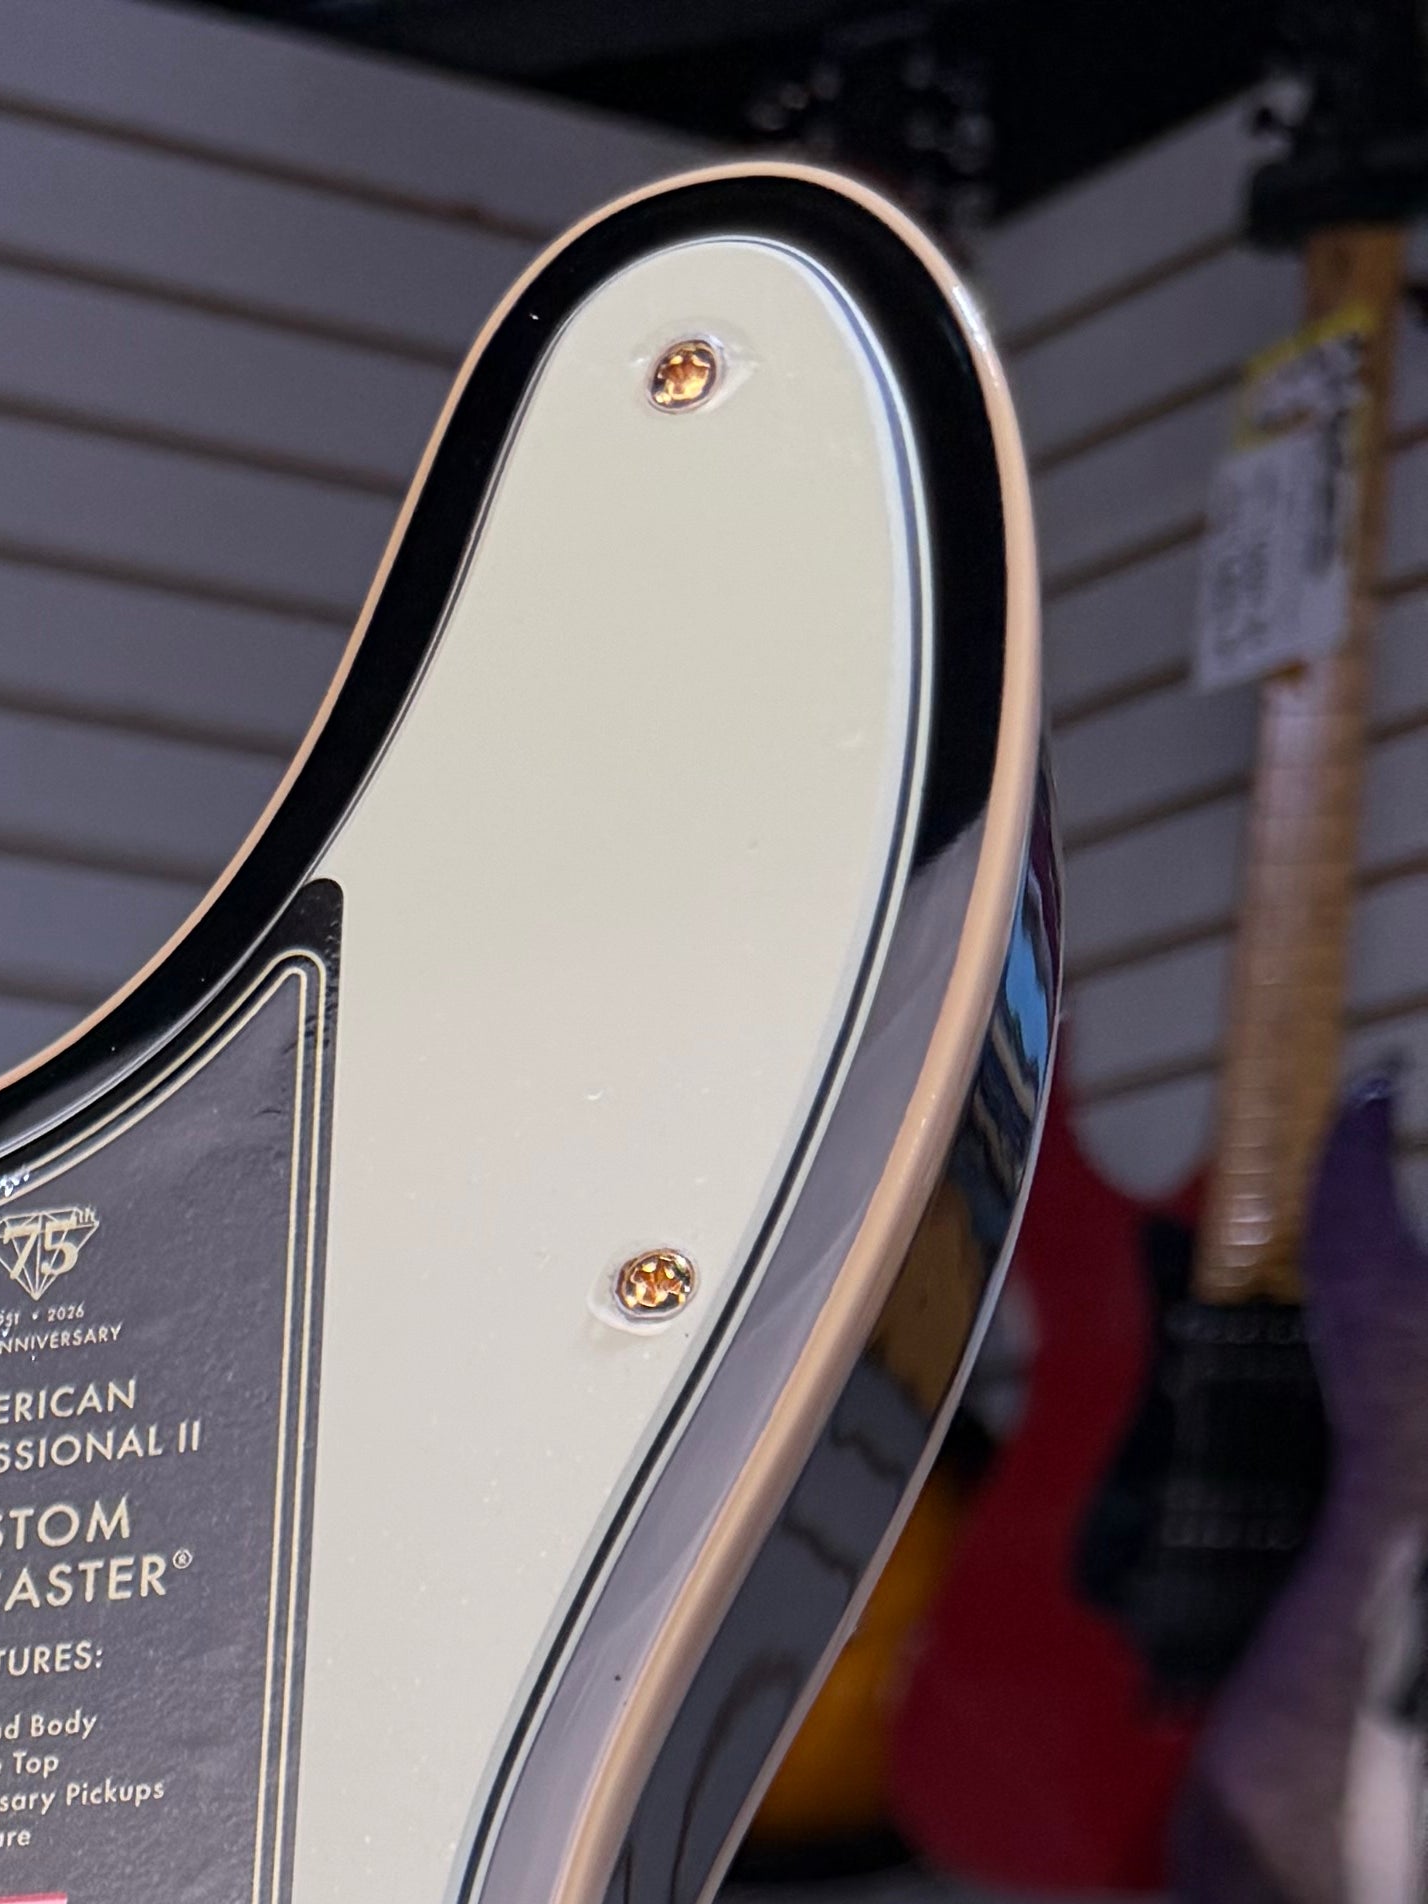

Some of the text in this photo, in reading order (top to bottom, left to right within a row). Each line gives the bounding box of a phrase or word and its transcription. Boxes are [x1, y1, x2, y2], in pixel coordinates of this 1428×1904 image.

[47, 1303, 85, 1322] 2026
[178, 1420, 201, 1453] II
[30, 1708, 97, 1739] Body
[13, 1751, 59, 1778] Top
[66, 1777, 165, 1807] Pickups
